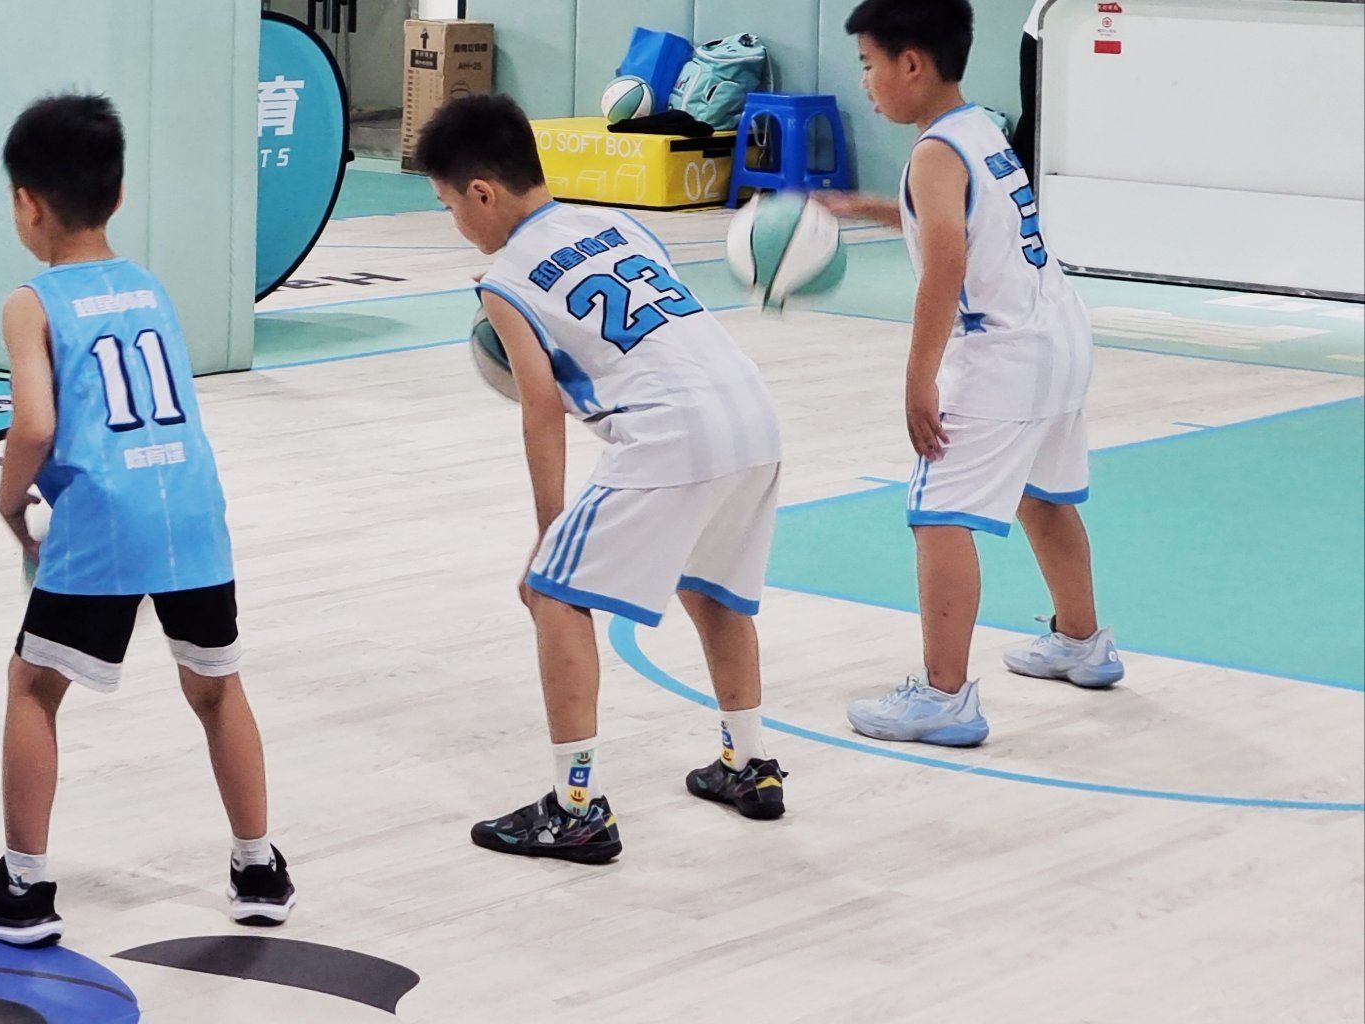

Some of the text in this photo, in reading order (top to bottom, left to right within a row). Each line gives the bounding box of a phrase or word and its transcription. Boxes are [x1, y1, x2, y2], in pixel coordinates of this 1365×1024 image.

[258, 75, 305, 137] 育
[557, 132, 601, 155] SOFT
[606, 136, 644, 158] BOX
[684, 159, 720, 201] 02
[565, 254, 704, 355] 23
[90, 328, 187, 433] 11
